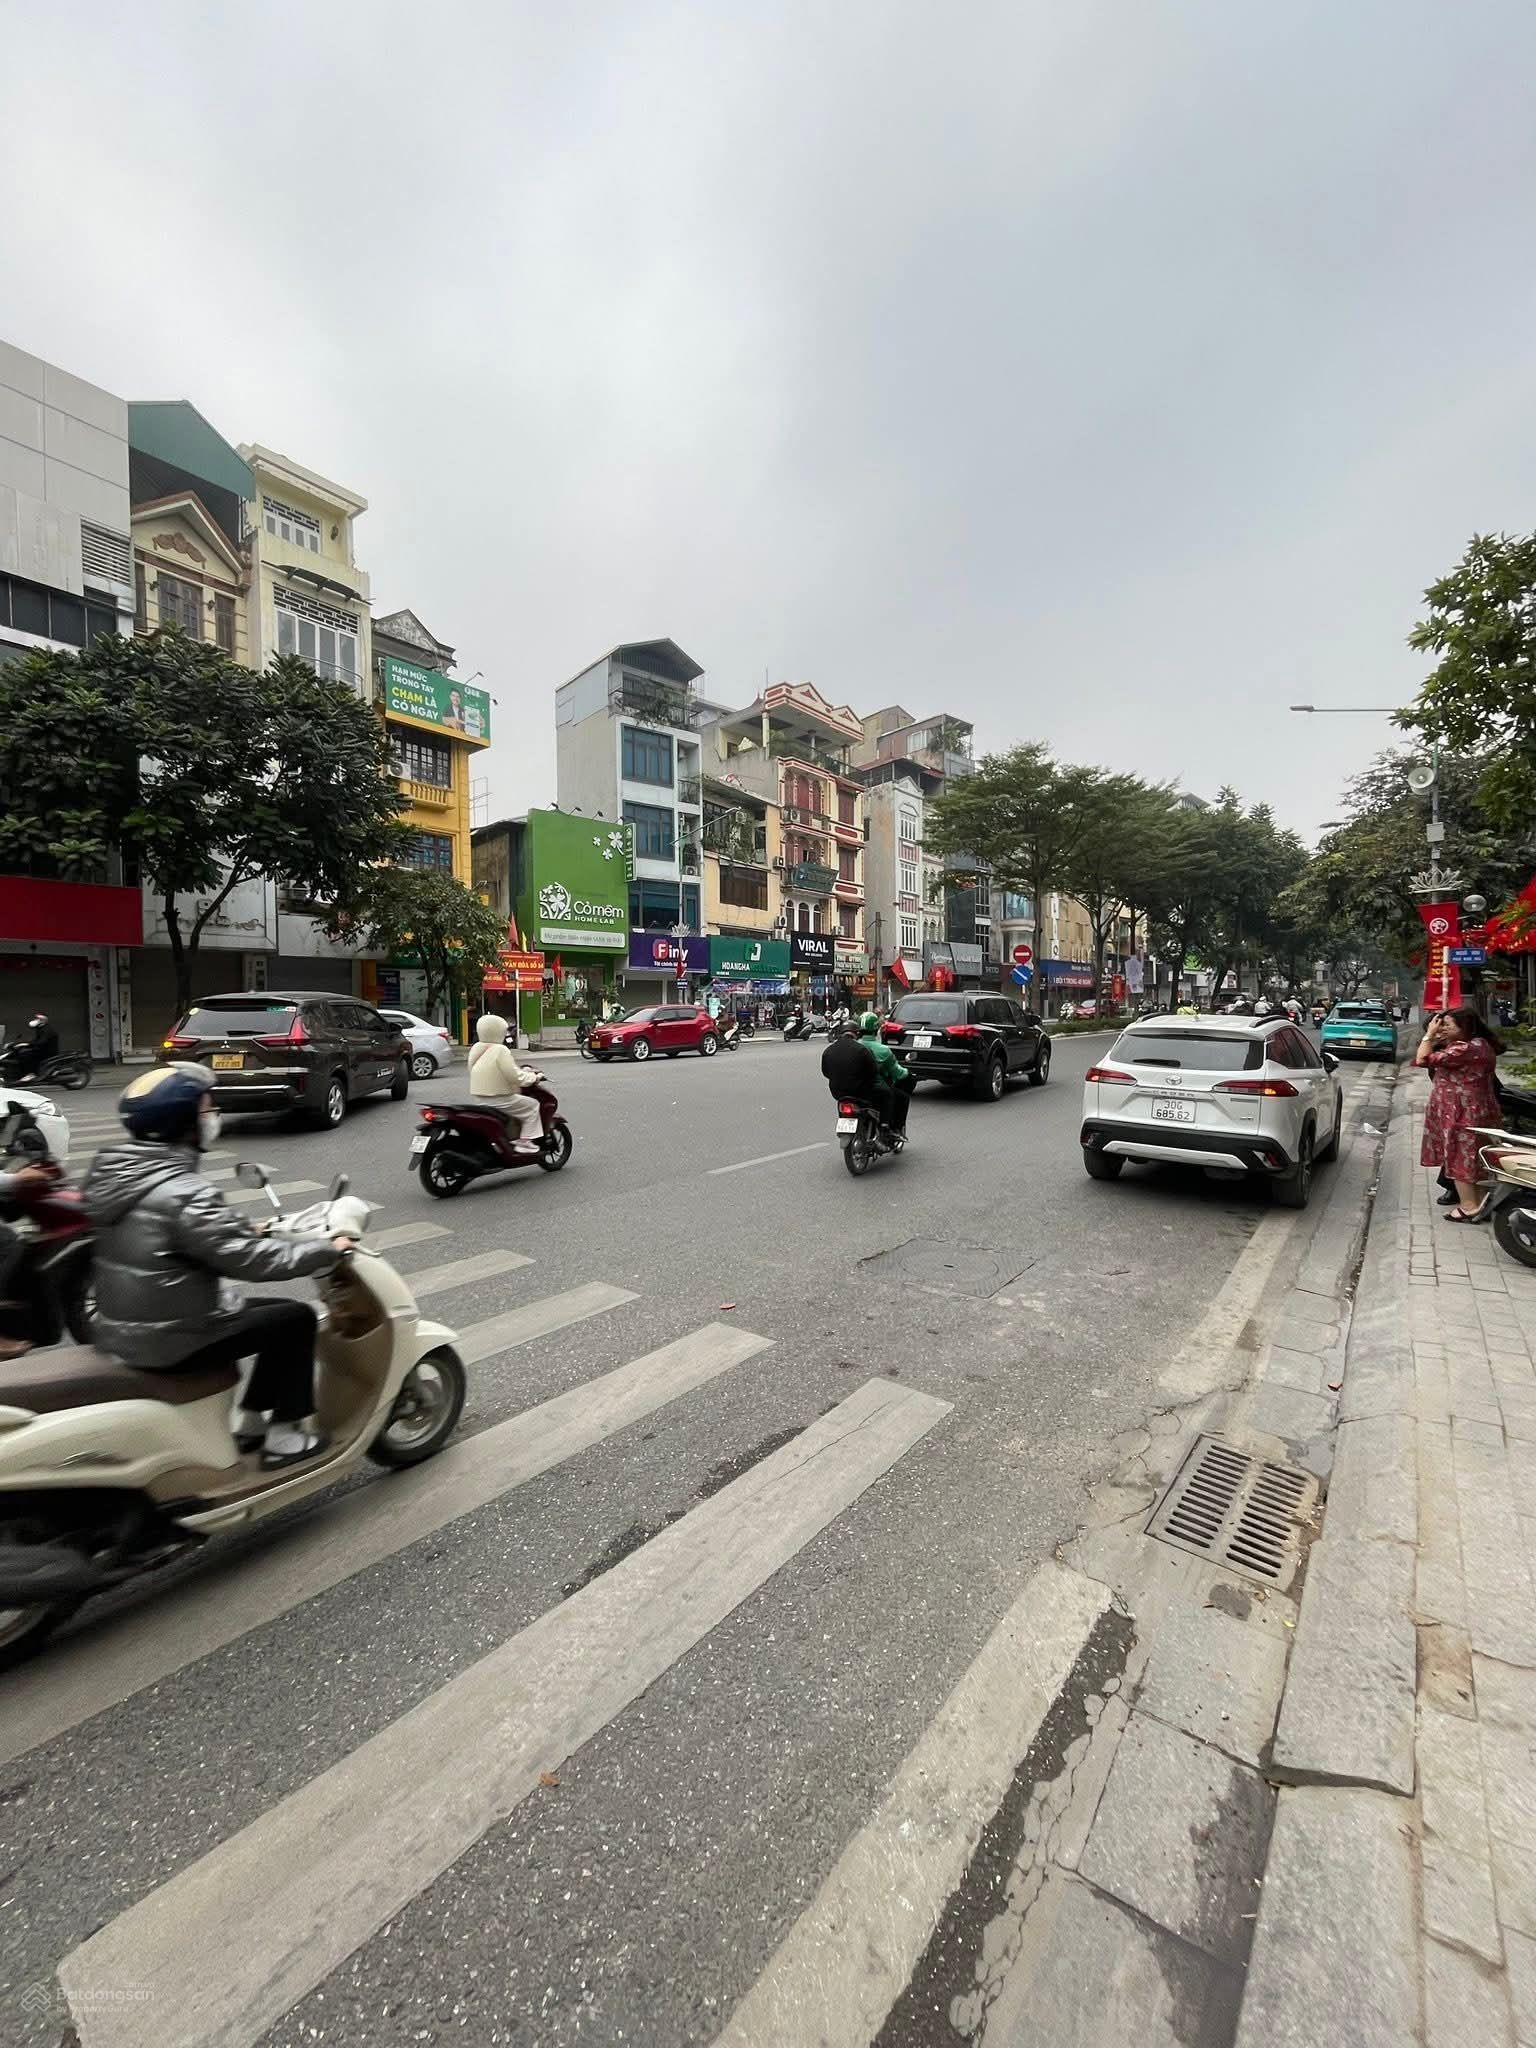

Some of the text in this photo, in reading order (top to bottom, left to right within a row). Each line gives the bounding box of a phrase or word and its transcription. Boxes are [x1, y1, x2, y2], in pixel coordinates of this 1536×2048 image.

[392, 674, 434, 693] TRONG TAY
[392, 687, 422, 704] CHẠM
[392, 699, 438, 720] CÓ NGAY
[658, 943, 689, 961] Finy
[798, 939, 829, 953] VIRAL
[1164, 1100, 1183, 1110] 30G
[1156, 1109, 1190, 1120] 685.62
